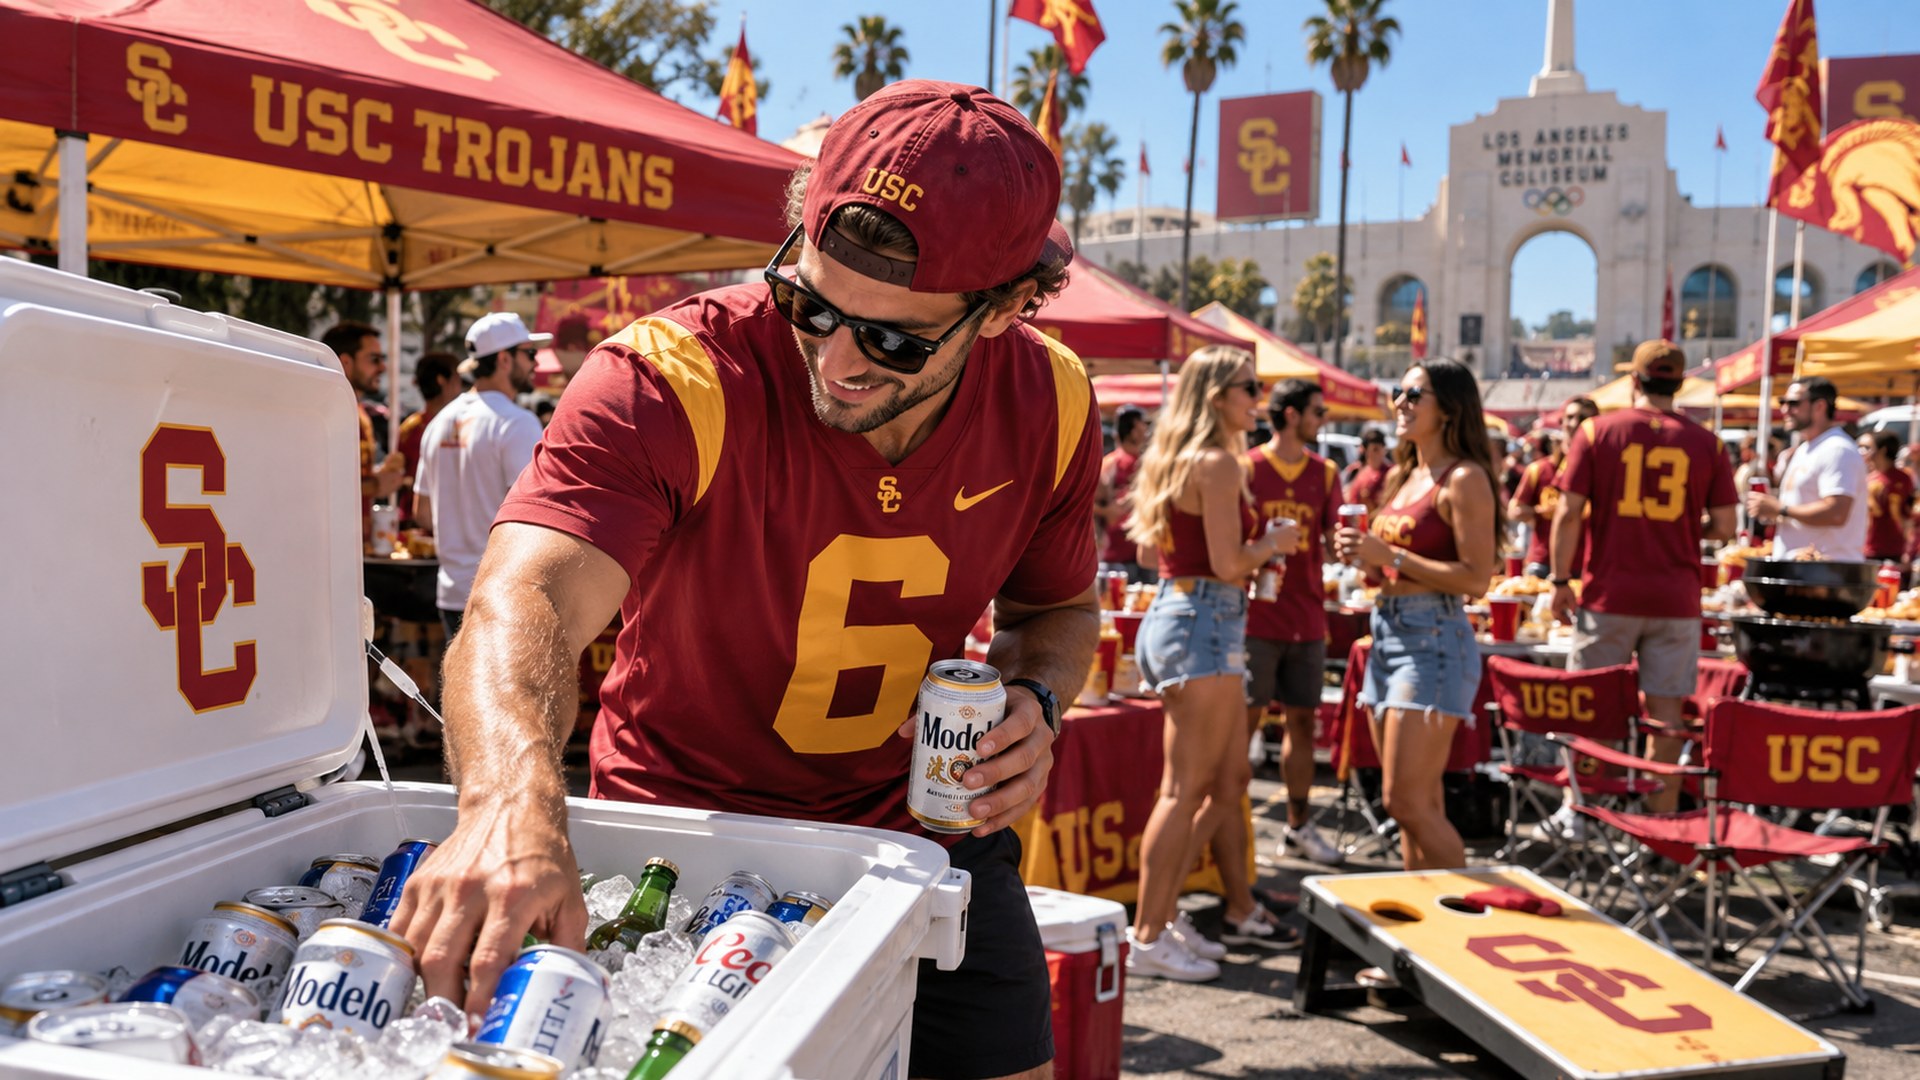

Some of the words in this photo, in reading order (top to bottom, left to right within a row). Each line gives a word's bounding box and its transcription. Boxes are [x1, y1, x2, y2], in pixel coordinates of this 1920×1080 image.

[126, 41, 188, 135] SC
[250, 75, 393, 164] USC
[414, 108, 675, 210] TROJANS
[1238, 117, 1291, 196] SC
[1482, 130, 1520, 149] LOS
[1535, 123, 1629, 145] ANGELES
[1498, 146, 1613, 167] MEMORIAL
[862, 167, 924, 213] USC
[1500, 166, 1607, 187] COLISEUM
[877, 476, 902, 513] SC
[1617, 443, 1691, 522] 13
[140, 421, 258, 715] SC
[773, 533, 951, 755] 6
[1519, 682, 1596, 722] USC
[1766, 735, 1881, 784] USC
[283, 965, 393, 1031] Modelo
[1465, 934, 1714, 1034] SC
